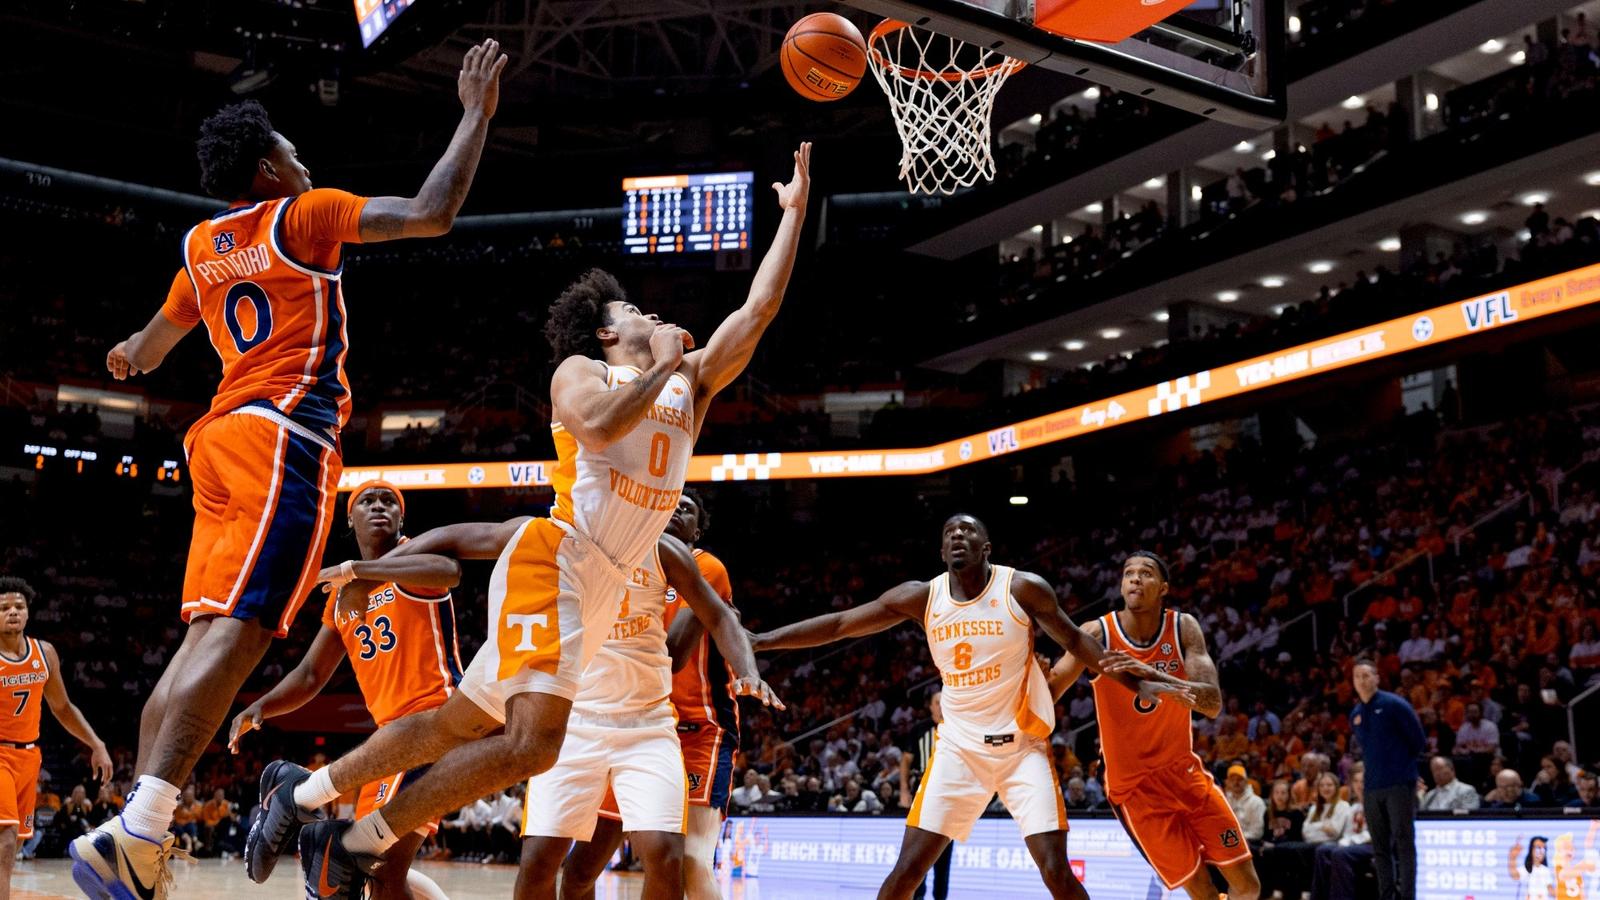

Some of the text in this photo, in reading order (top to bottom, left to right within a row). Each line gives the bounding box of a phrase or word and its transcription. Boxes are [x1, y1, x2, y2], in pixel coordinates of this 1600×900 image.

[806, 71, 848, 95] ELITE
[196, 243, 270, 285] PETTIFORD
[224, 280, 273, 355] 0
[1462, 293, 1516, 330] VFL
[988, 427, 1018, 454] VFL
[36, 455, 44, 469] 2
[77, 460, 83, 473] 1
[649, 432, 670, 478] 0
[508, 464, 547, 484] VFL
[354, 615, 397, 660] 33
[507, 614, 547, 651] T
[932, 620, 1004, 643] TENNESSEE
[954, 642, 972, 671] 6
[0, 671, 47, 687] IGERS
[13, 689, 30, 717] 7
[1422, 829, 1456, 845] THE
[822, 842, 851, 863] THE
[855, 843, 897, 865] KEYS
[956, 846, 991, 868] THE
[1423, 849, 1497, 867] DRIVES
[1424, 870, 1497, 890] SOBER
